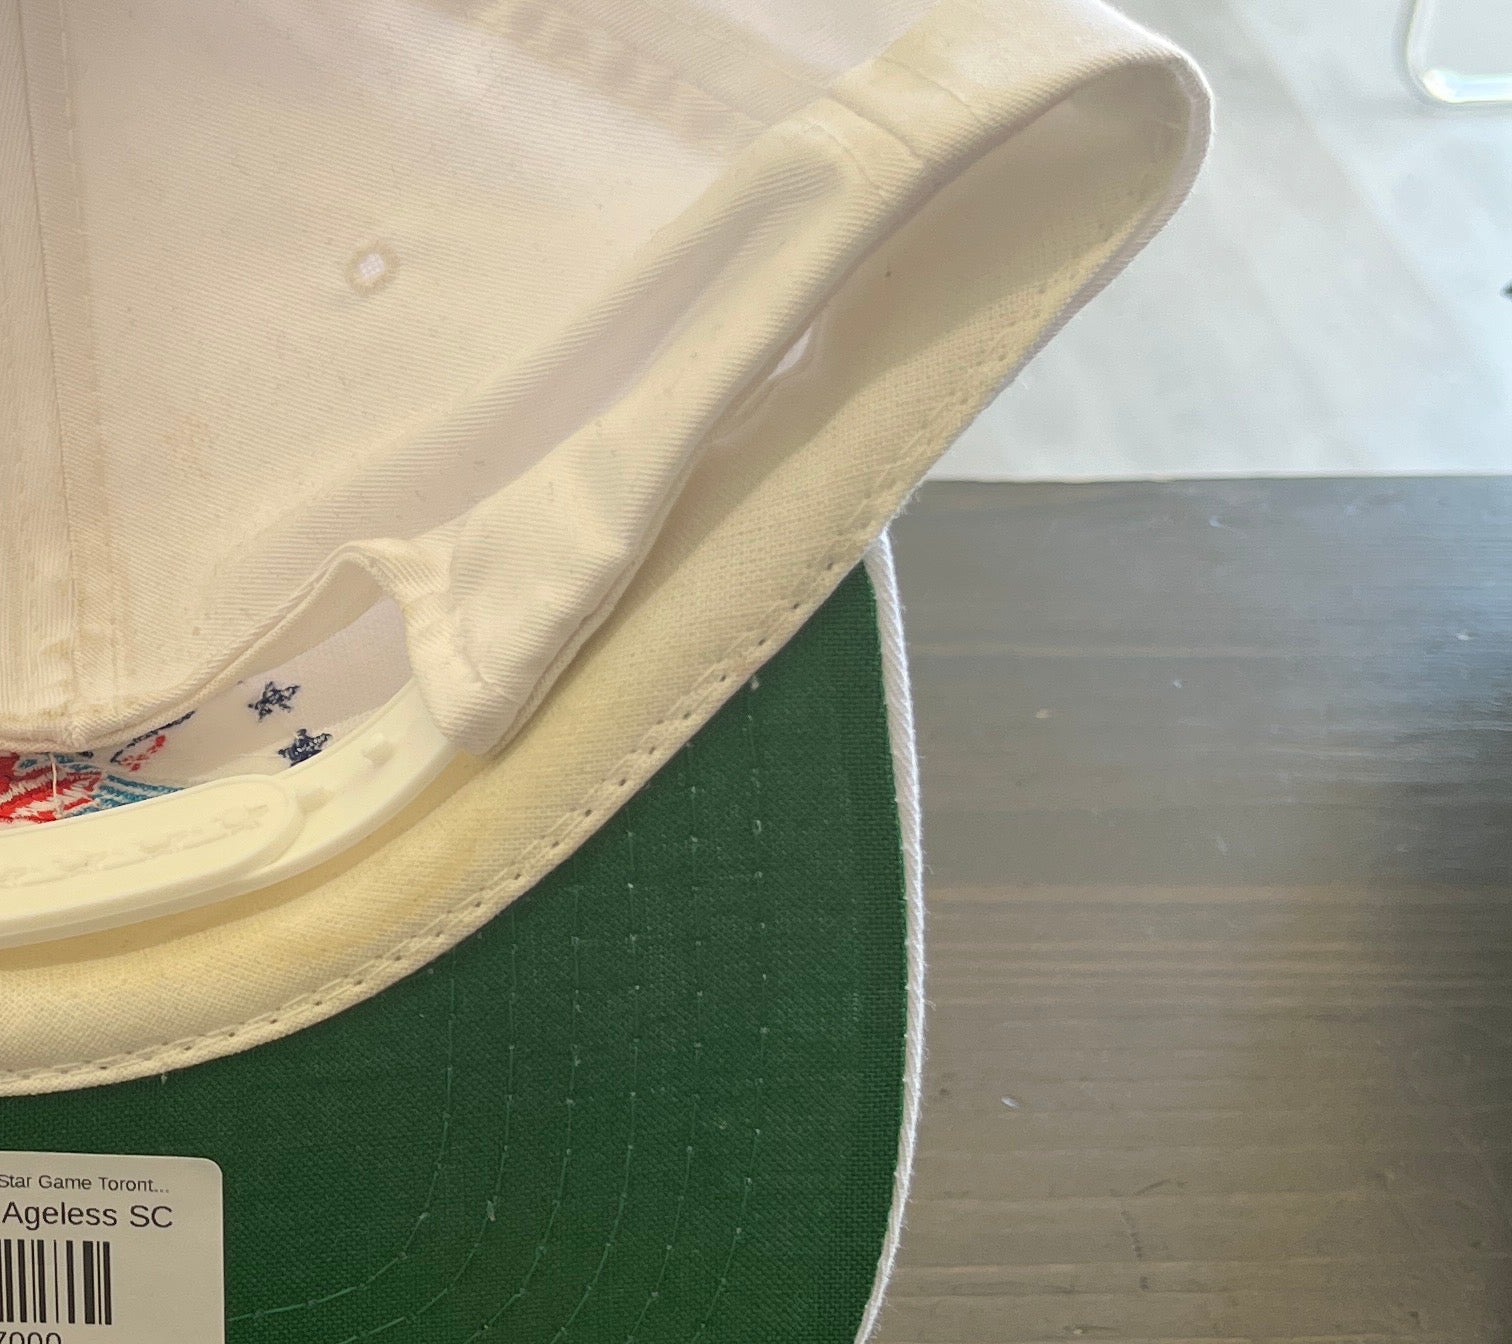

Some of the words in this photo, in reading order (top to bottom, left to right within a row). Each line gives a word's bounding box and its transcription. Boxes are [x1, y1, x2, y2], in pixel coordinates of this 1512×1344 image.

[38, 1174, 93, 1191] Game
[1, 1201, 118, 1231] Ageless
[129, 1204, 173, 1229] SC
